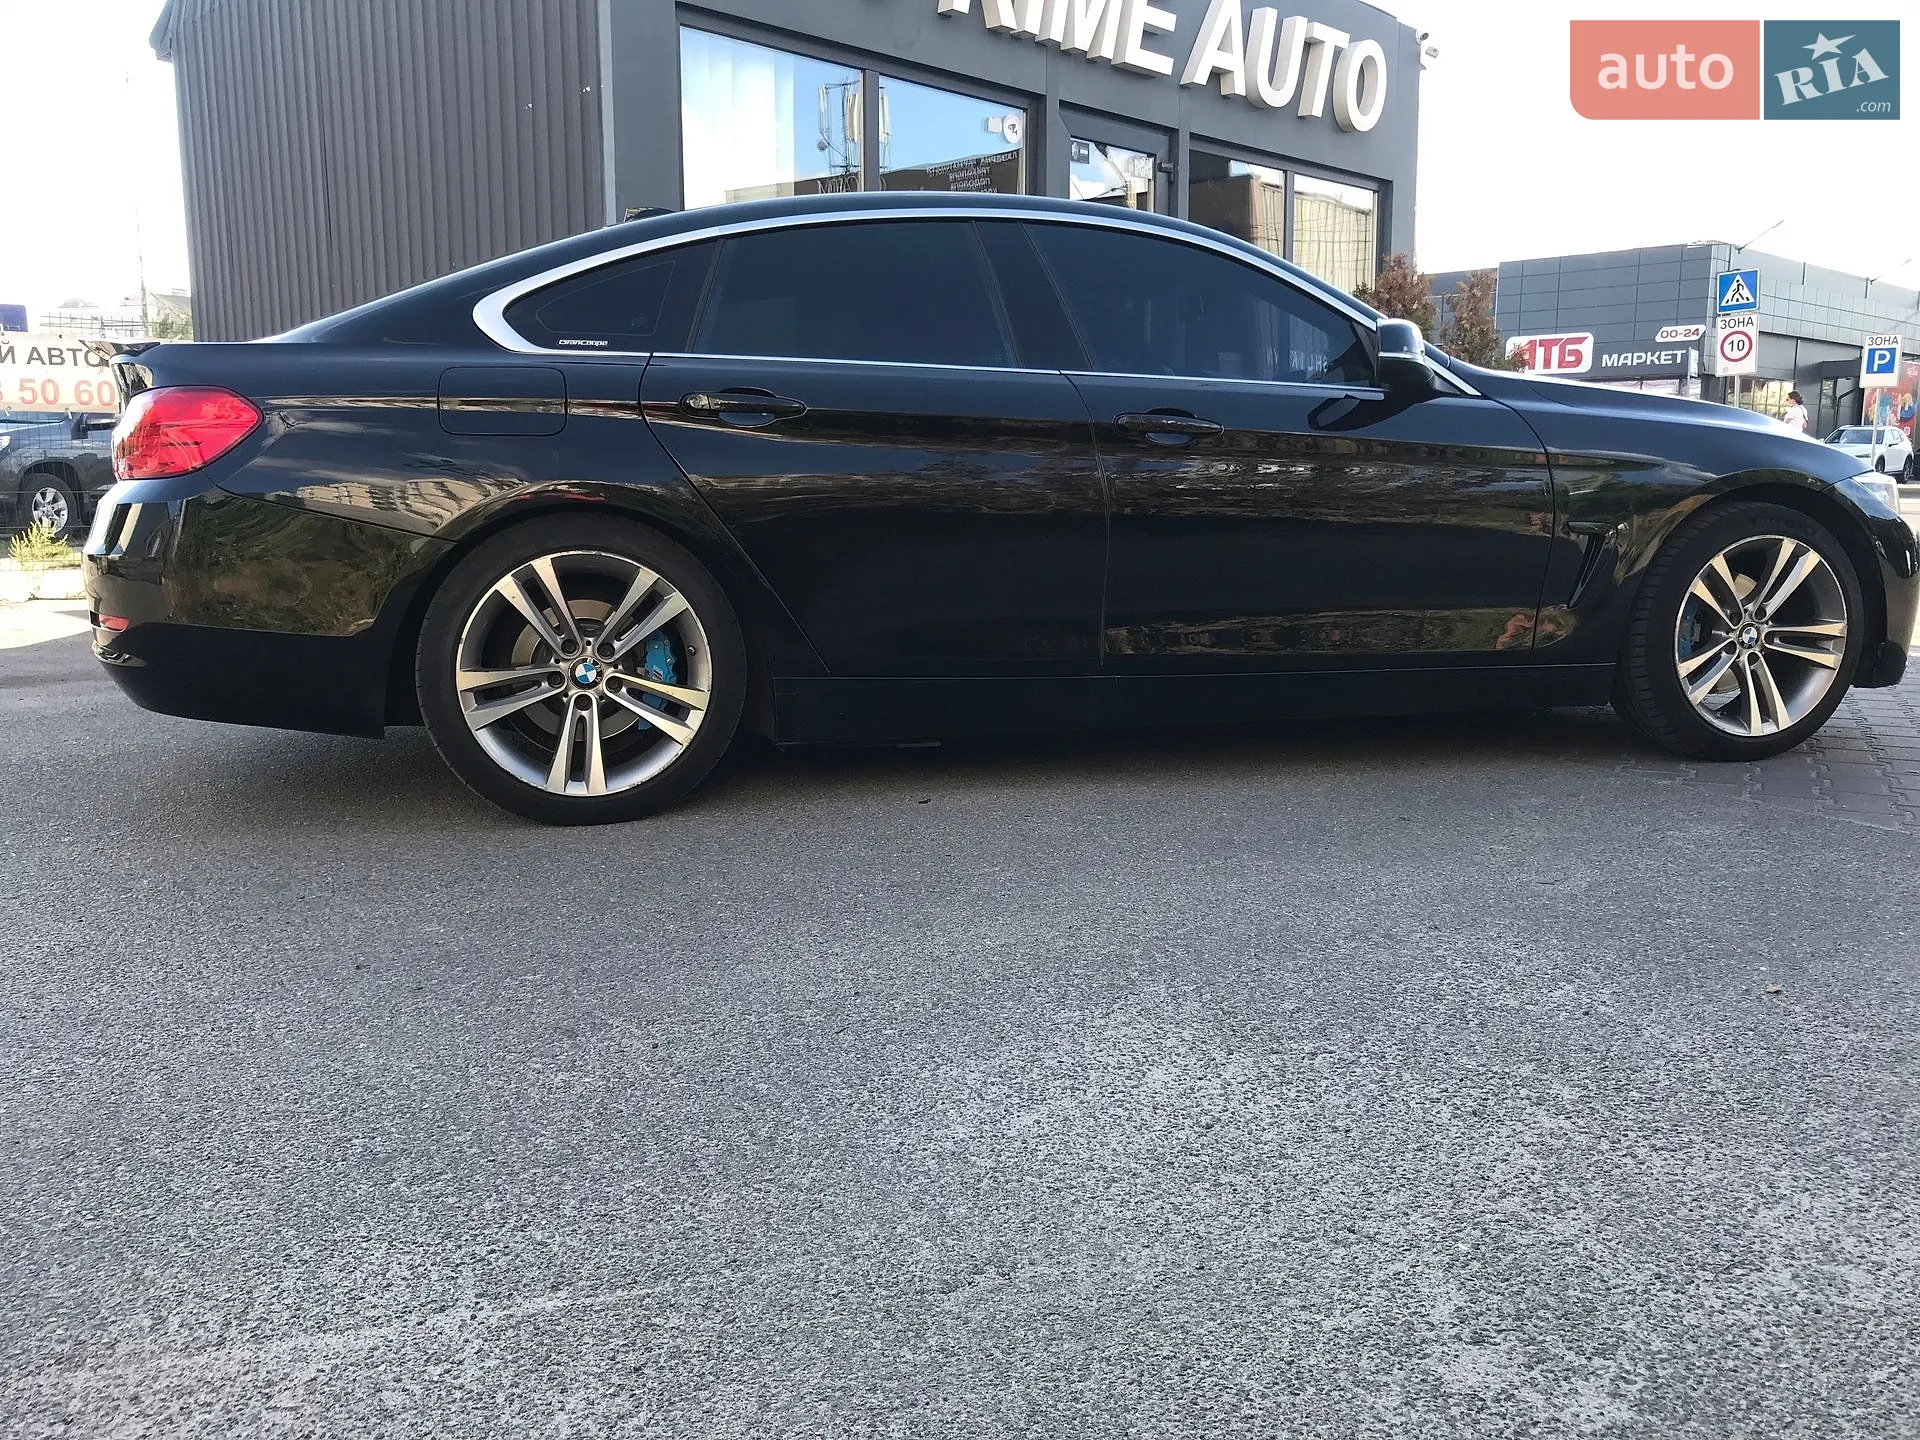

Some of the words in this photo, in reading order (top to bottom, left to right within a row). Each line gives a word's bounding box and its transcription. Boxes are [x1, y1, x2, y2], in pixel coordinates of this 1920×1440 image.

[1180, 0, 1387, 132] AUTO
[1720, 316, 1755, 330] ЗОНА
[1728, 339, 1745, 352] 10
[1867, 335, 1899, 346] ЗОНА
[1516, 336, 1589, 371] АТБ
[1601, 350, 1687, 368] МАРКЕТ
[1873, 350, 1891, 372] P
[19, 378, 60, 405] 50
[74, 379, 116, 407] 60
